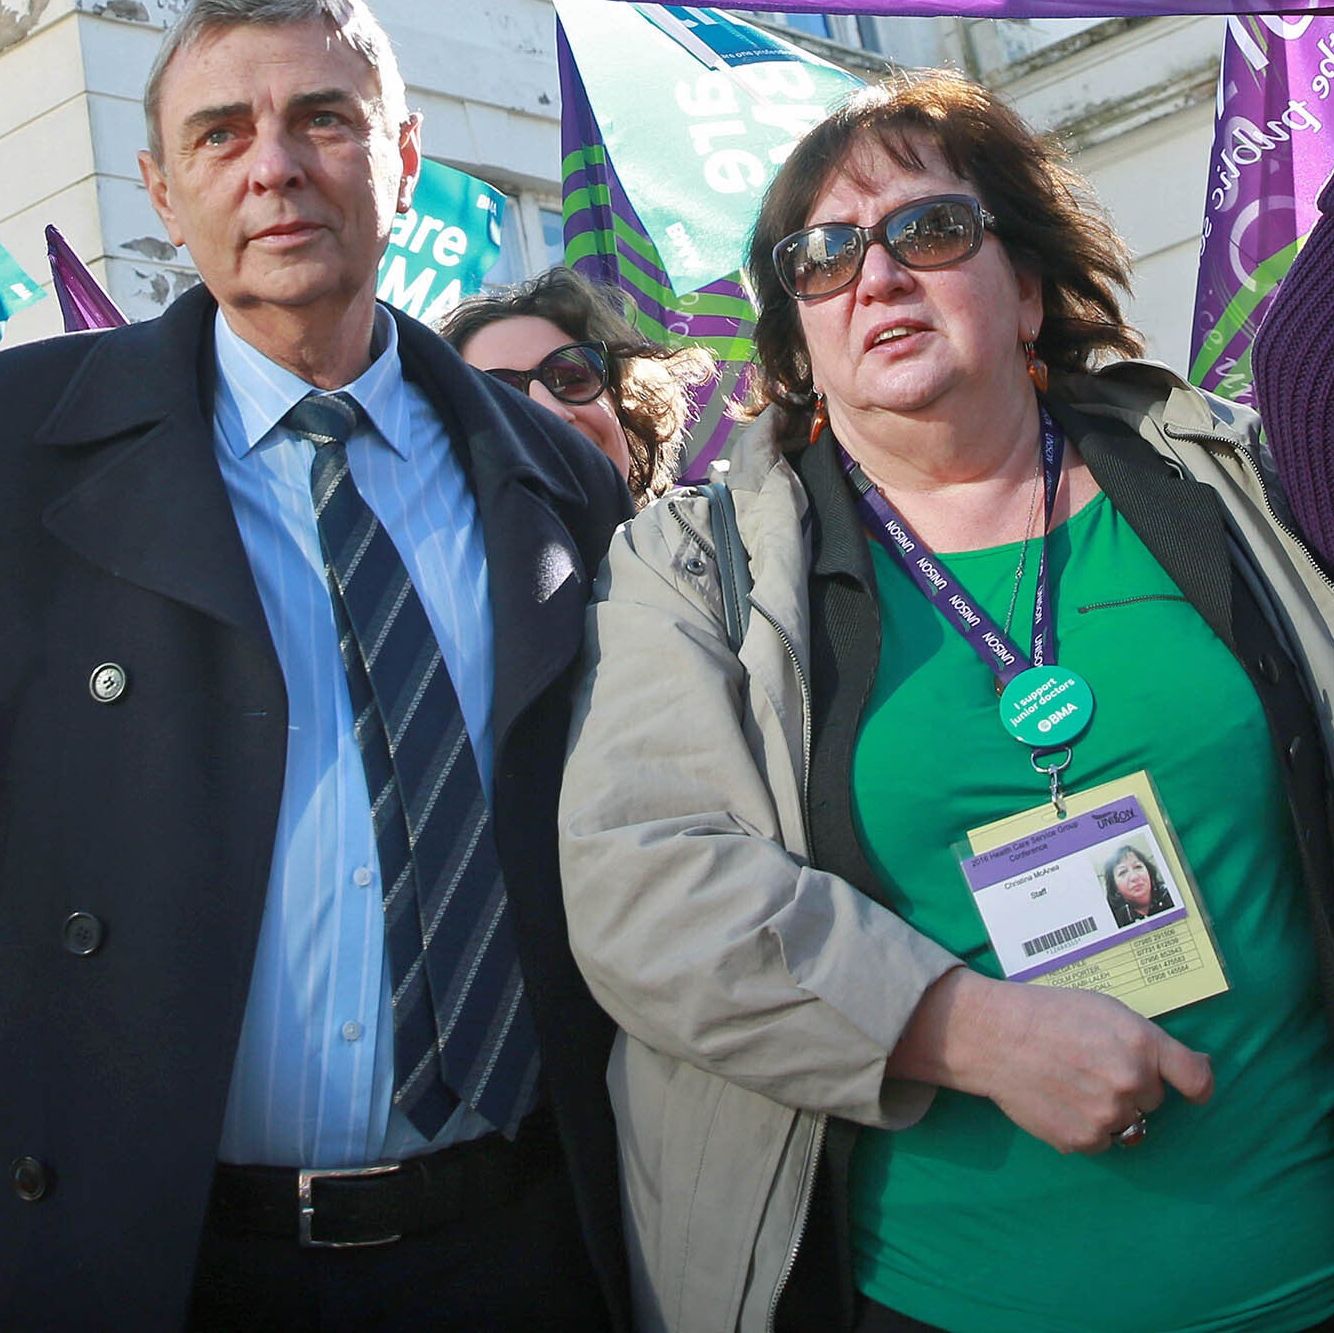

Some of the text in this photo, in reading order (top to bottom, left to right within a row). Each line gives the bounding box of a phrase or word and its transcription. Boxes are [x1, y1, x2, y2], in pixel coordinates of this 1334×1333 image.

[389, 208, 468, 267] are
[376, 254, 462, 322] MA
[885, 520, 916, 553] UNISON
[917, 557, 948, 590] UNISON
[948, 594, 981, 627] UNISON
[982, 631, 1015, 666] UNISON
[1033, 633, 1044, 667] UNISO
[1009, 678, 1076, 728] junior doctors
[1020, 677, 1058, 707] support
[1048, 702, 1079, 726] BMA
[1097, 808, 1135, 830] UNISON
[989, 844, 1013, 861] Health
[1013, 838, 1030, 852] Care
[1031, 829, 1057, 845] Service
[1057, 820, 1080, 835] Group
[1009, 842, 1049, 864] Conference
[1004, 874, 1034, 891] Christina
[1030, 886, 1049, 901] Staff
